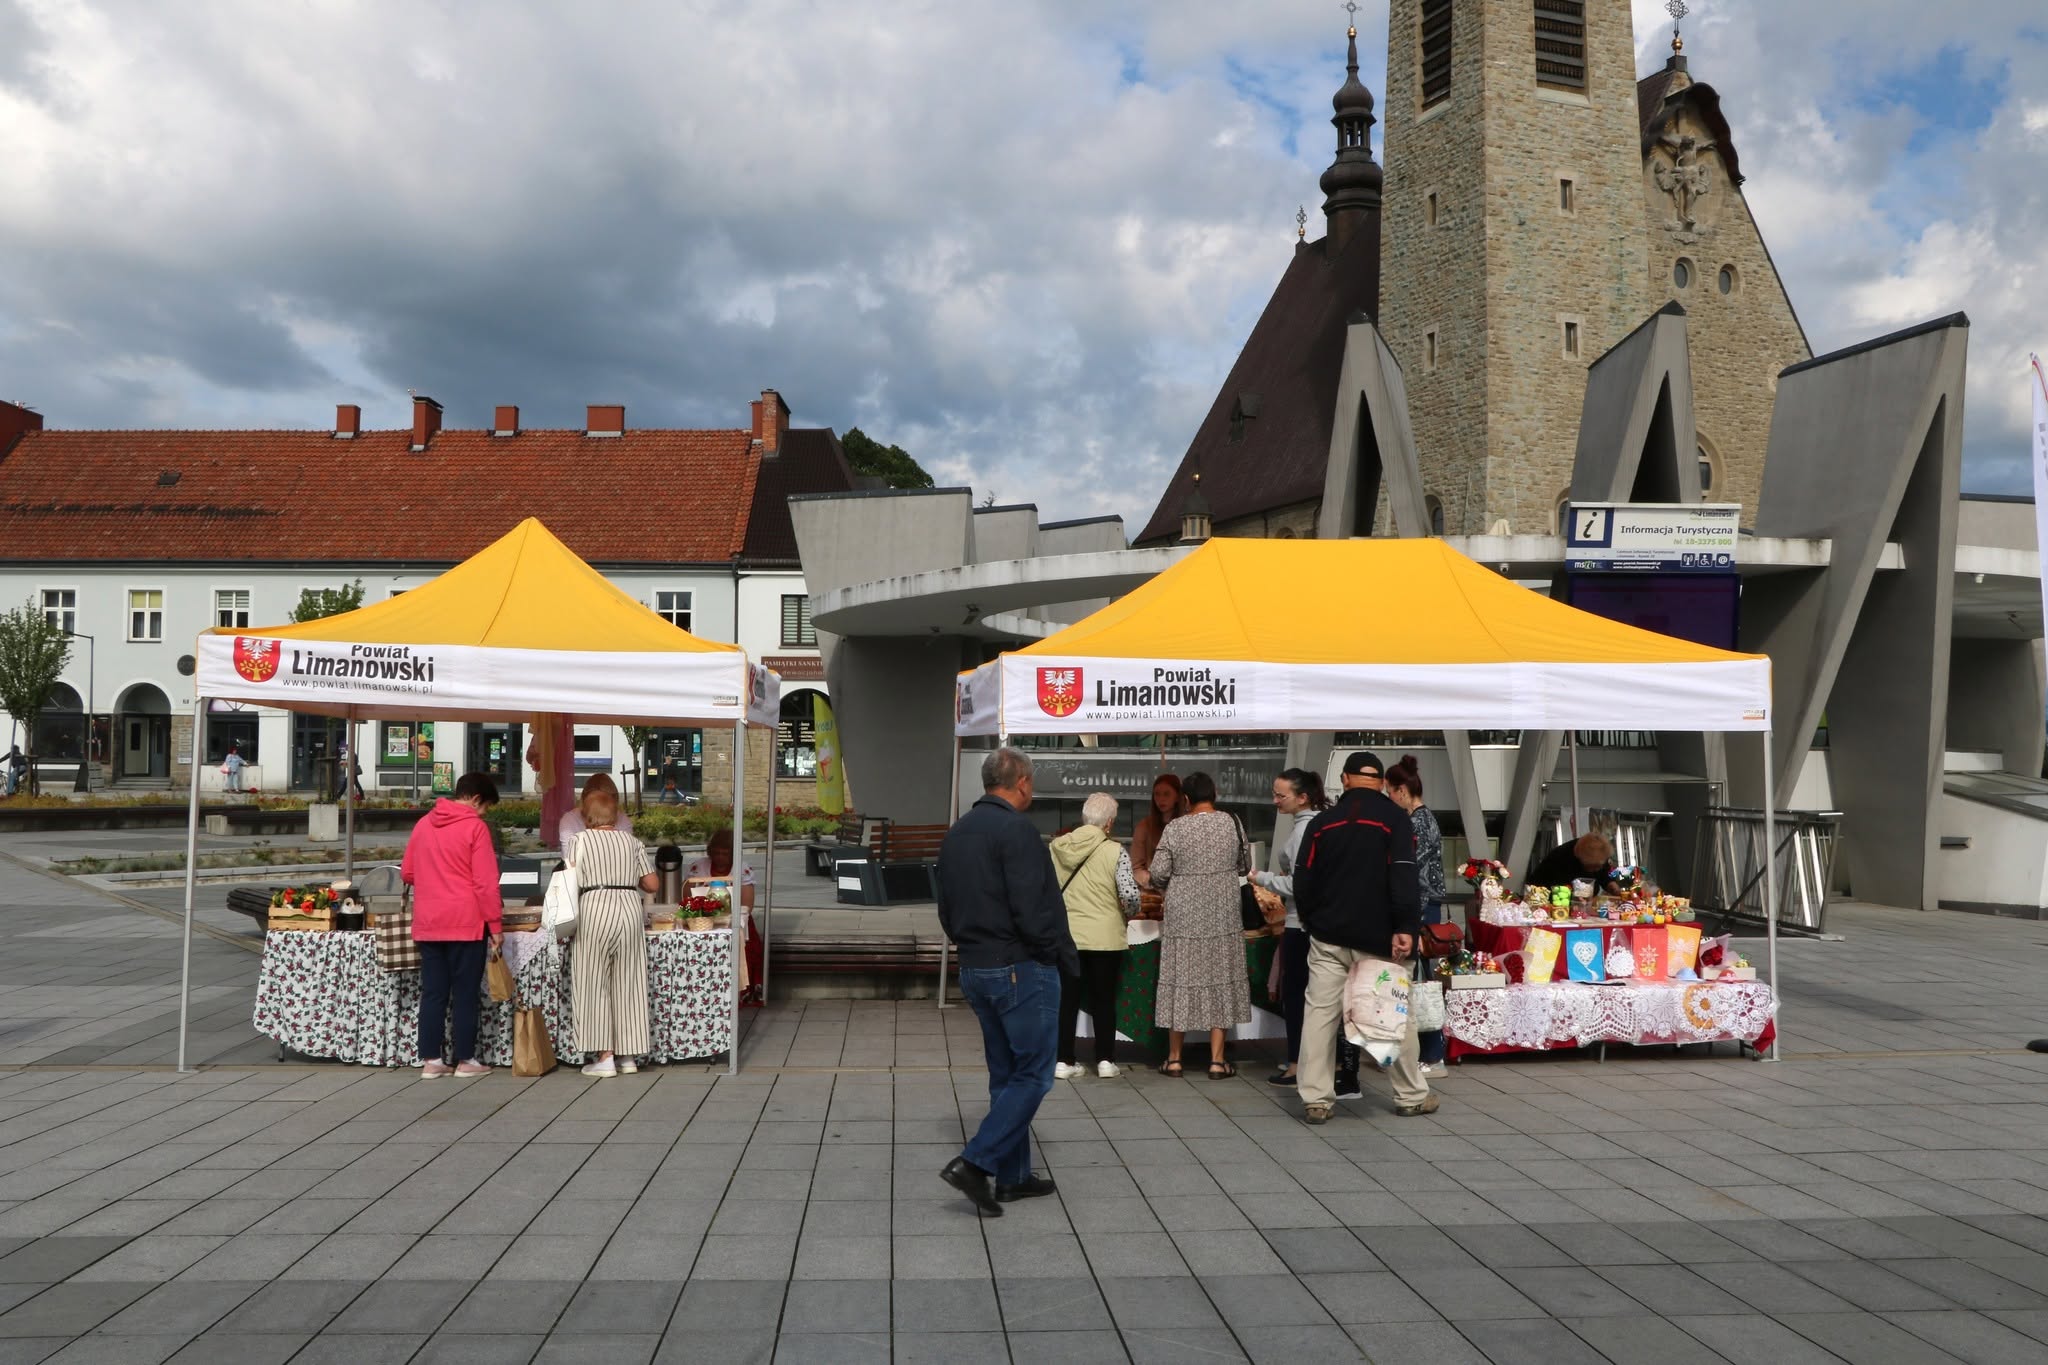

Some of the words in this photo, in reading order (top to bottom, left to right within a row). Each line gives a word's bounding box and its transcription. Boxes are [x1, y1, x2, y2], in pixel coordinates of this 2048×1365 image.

[1621, 525, 1673, 536] Informacja
[1676, 526, 1733, 536] Turystyczna
[351, 644, 409, 659] Powiat
[292, 650, 434, 682] Limanowski
[1154, 667, 1211, 682] Powiat
[283, 678, 434, 694] www.powiat.limanowski.pl
[1096, 679, 1235, 706] Limanowski
[1086, 709, 1236, 719] www.powiat.limanowski.pl
